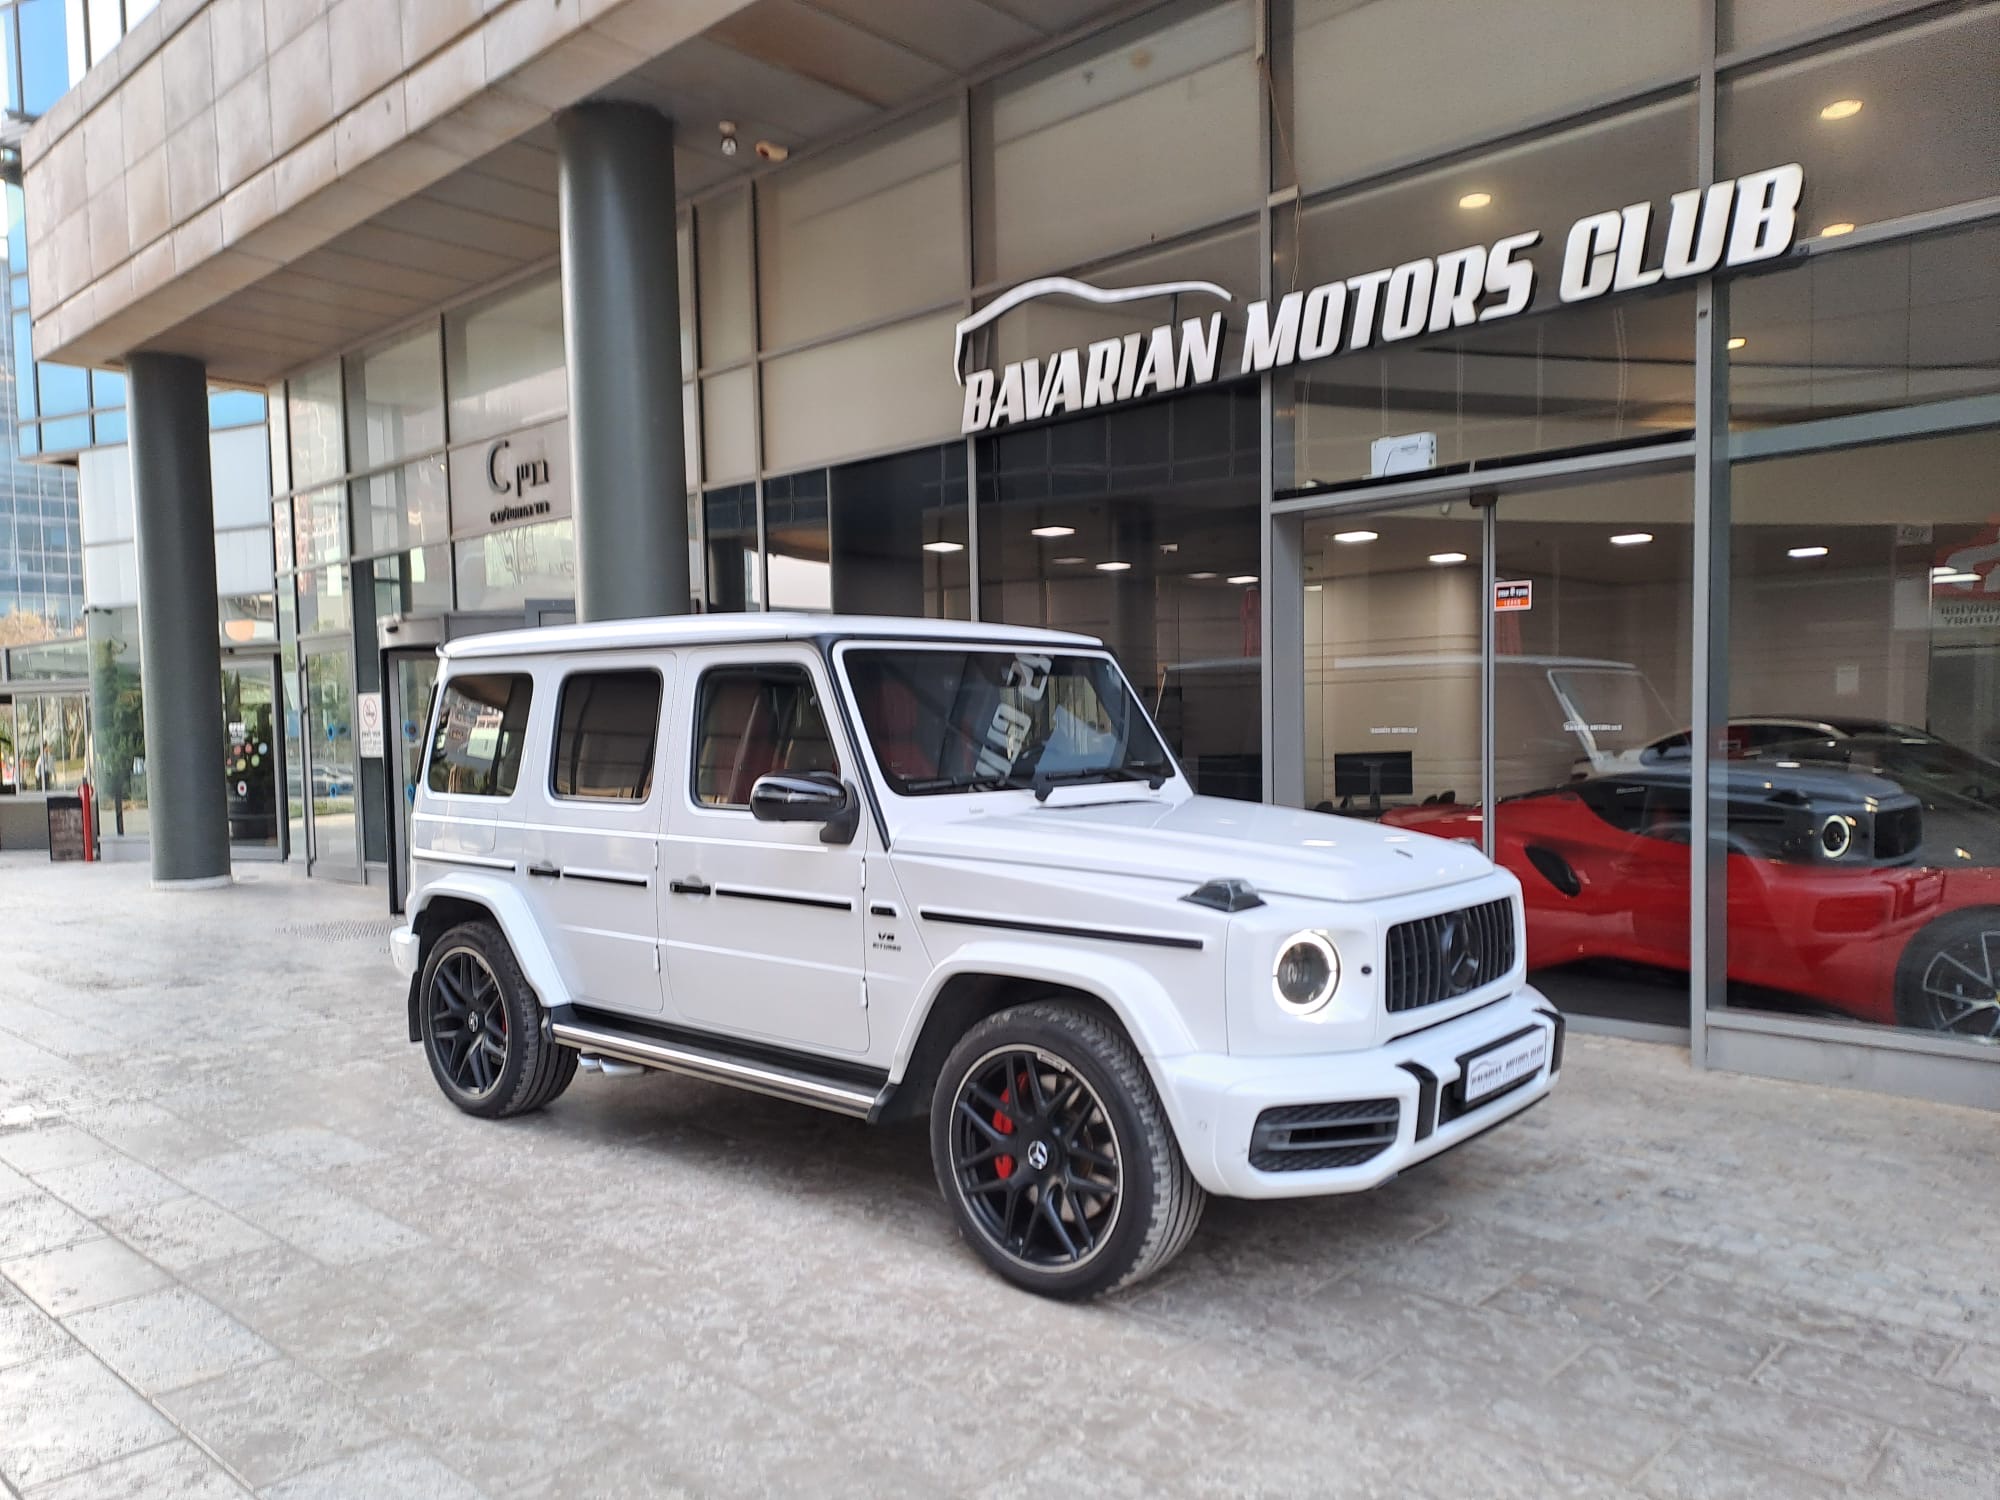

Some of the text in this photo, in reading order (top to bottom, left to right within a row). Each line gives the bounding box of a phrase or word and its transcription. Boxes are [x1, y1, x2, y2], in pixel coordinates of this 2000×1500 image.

[961, 162, 1805, 434] BAVARIAN MOTORS CLUB
[486, 439, 549, 497] בניין C
